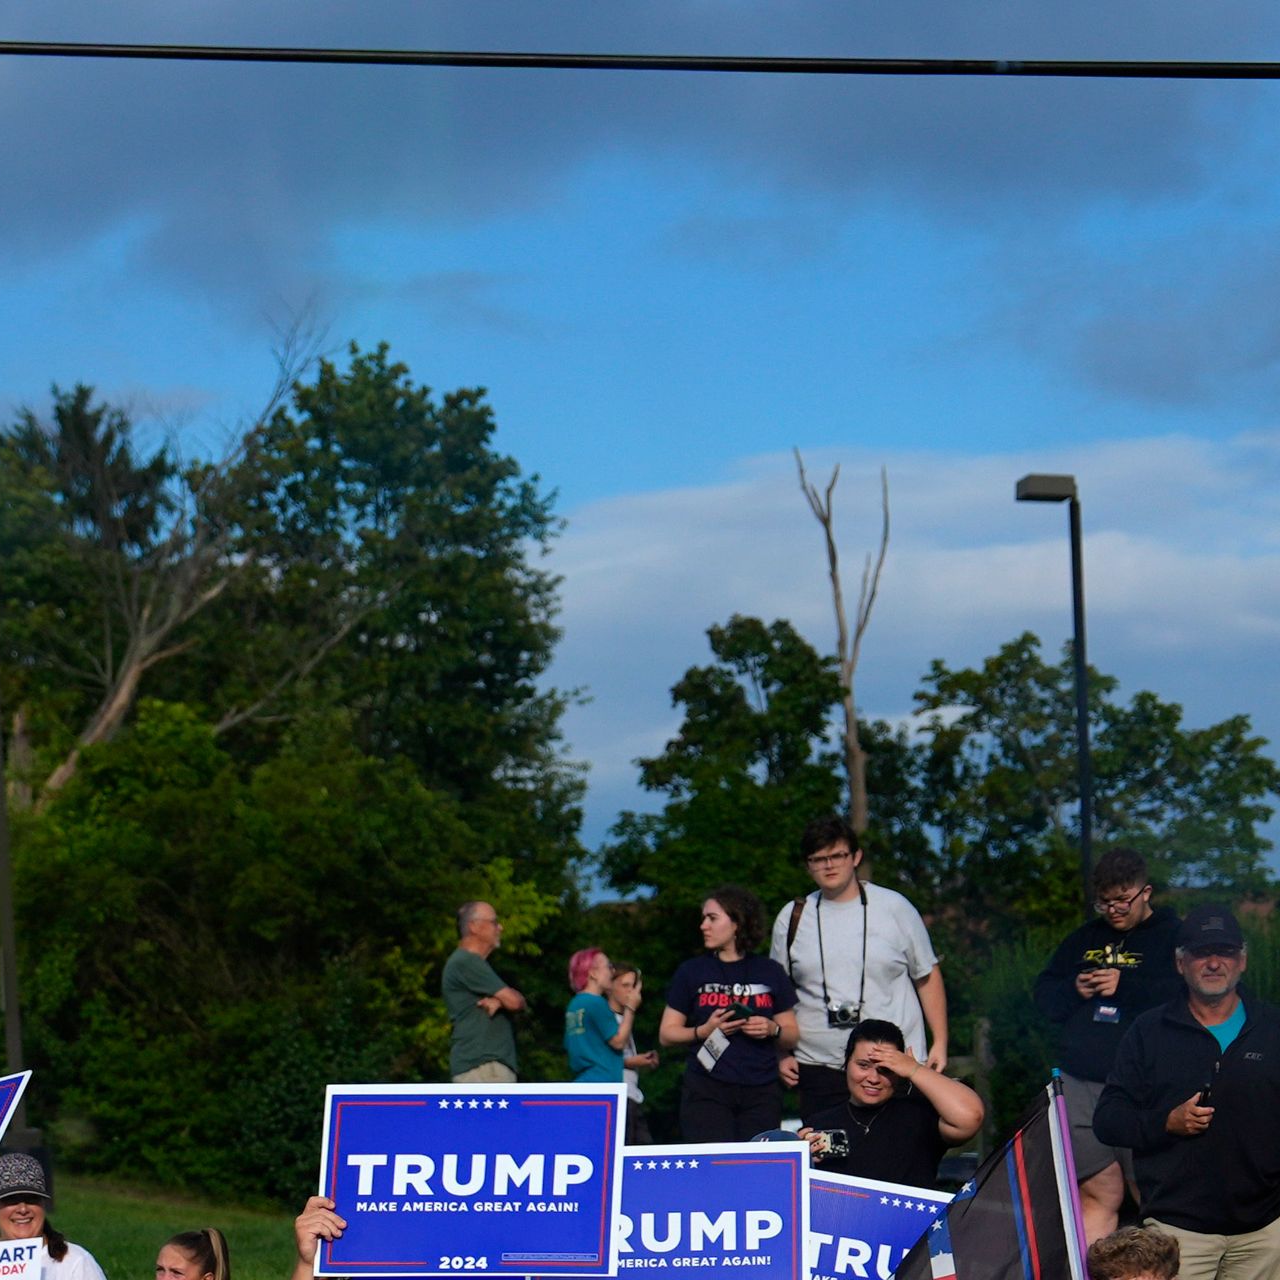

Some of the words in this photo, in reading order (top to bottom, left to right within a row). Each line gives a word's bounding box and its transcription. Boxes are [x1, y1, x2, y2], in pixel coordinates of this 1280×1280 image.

[346, 1154, 595, 1196] TRUMP
[356, 1202, 397, 1212] MAKE
[402, 1202, 469, 1212] AMERICA
[473, 1202, 522, 1212] GREAT
[526, 1202, 579, 1212] AGAIN!
[617, 1210, 783, 1253] RUMP
[439, 1256, 488, 1269] 2024
[617, 1258, 668, 1268] MERICA
[672, 1257, 717, 1267] GREAT
[722, 1256, 771, 1267] AGAIN!
